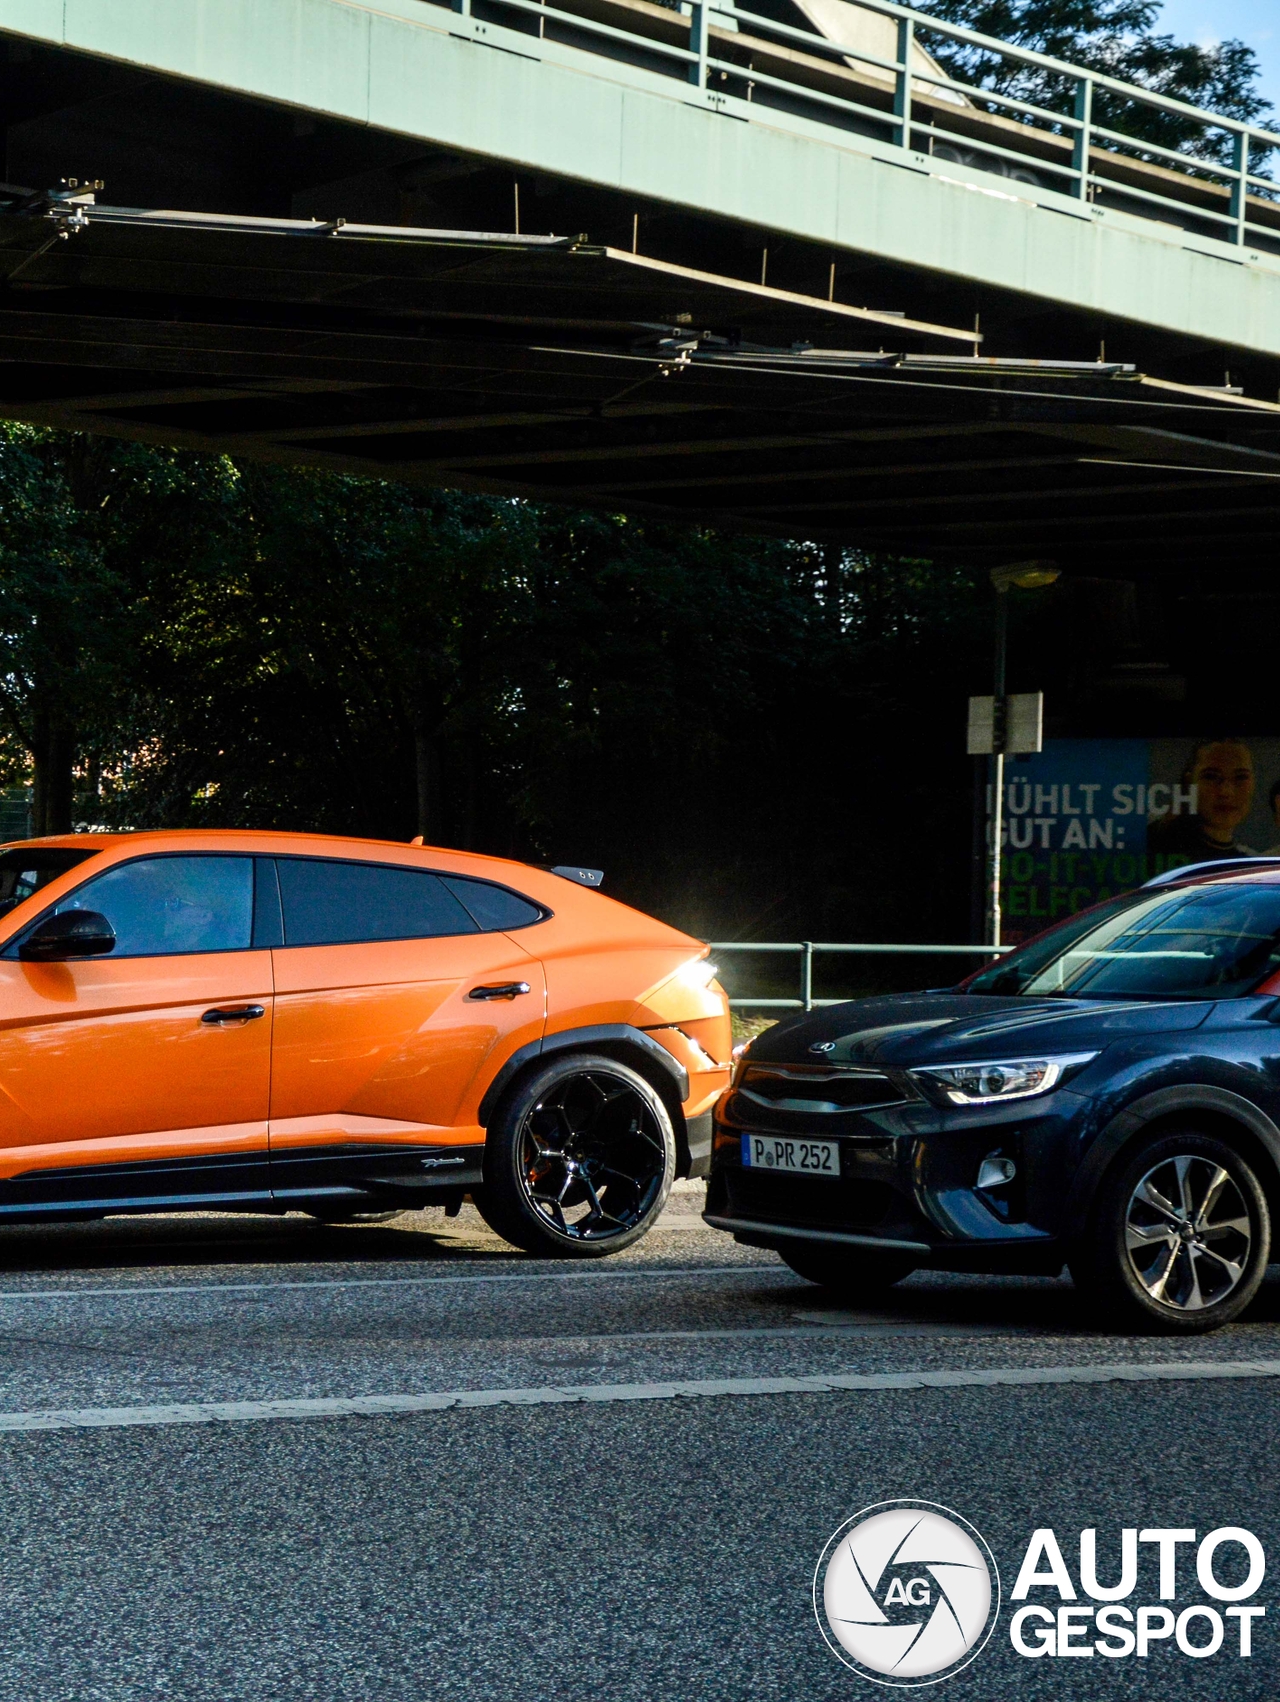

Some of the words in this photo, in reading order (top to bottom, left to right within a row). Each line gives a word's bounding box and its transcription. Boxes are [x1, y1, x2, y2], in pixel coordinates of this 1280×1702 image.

[1112, 783, 1199, 815] SICH
[1062, 817, 1125, 849] AN:
[754, 1139, 764, 1163] P
[774, 1141, 796, 1167] PR
[800, 1144, 832, 1170] 252
